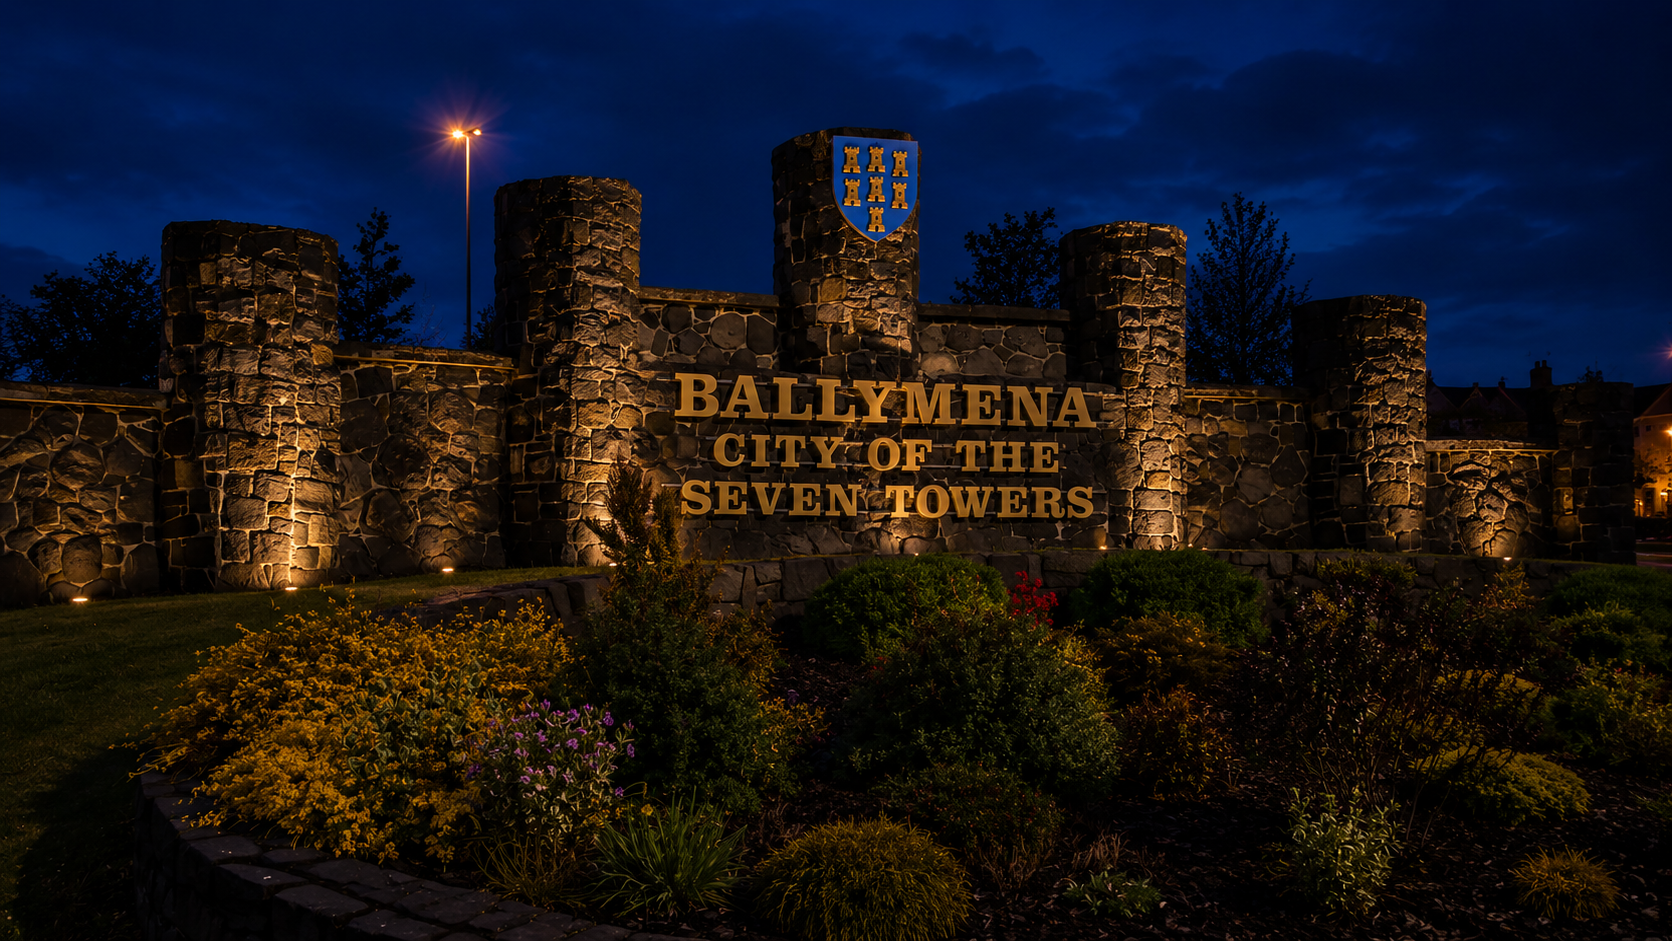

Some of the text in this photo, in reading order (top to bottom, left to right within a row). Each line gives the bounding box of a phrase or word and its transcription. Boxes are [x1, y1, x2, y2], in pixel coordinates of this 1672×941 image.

[674, 373, 1097, 428] BALLYMENA
[713, 433, 1059, 473] CITY OF THE
[681, 480, 1094, 519] SEVEN TOWERS
